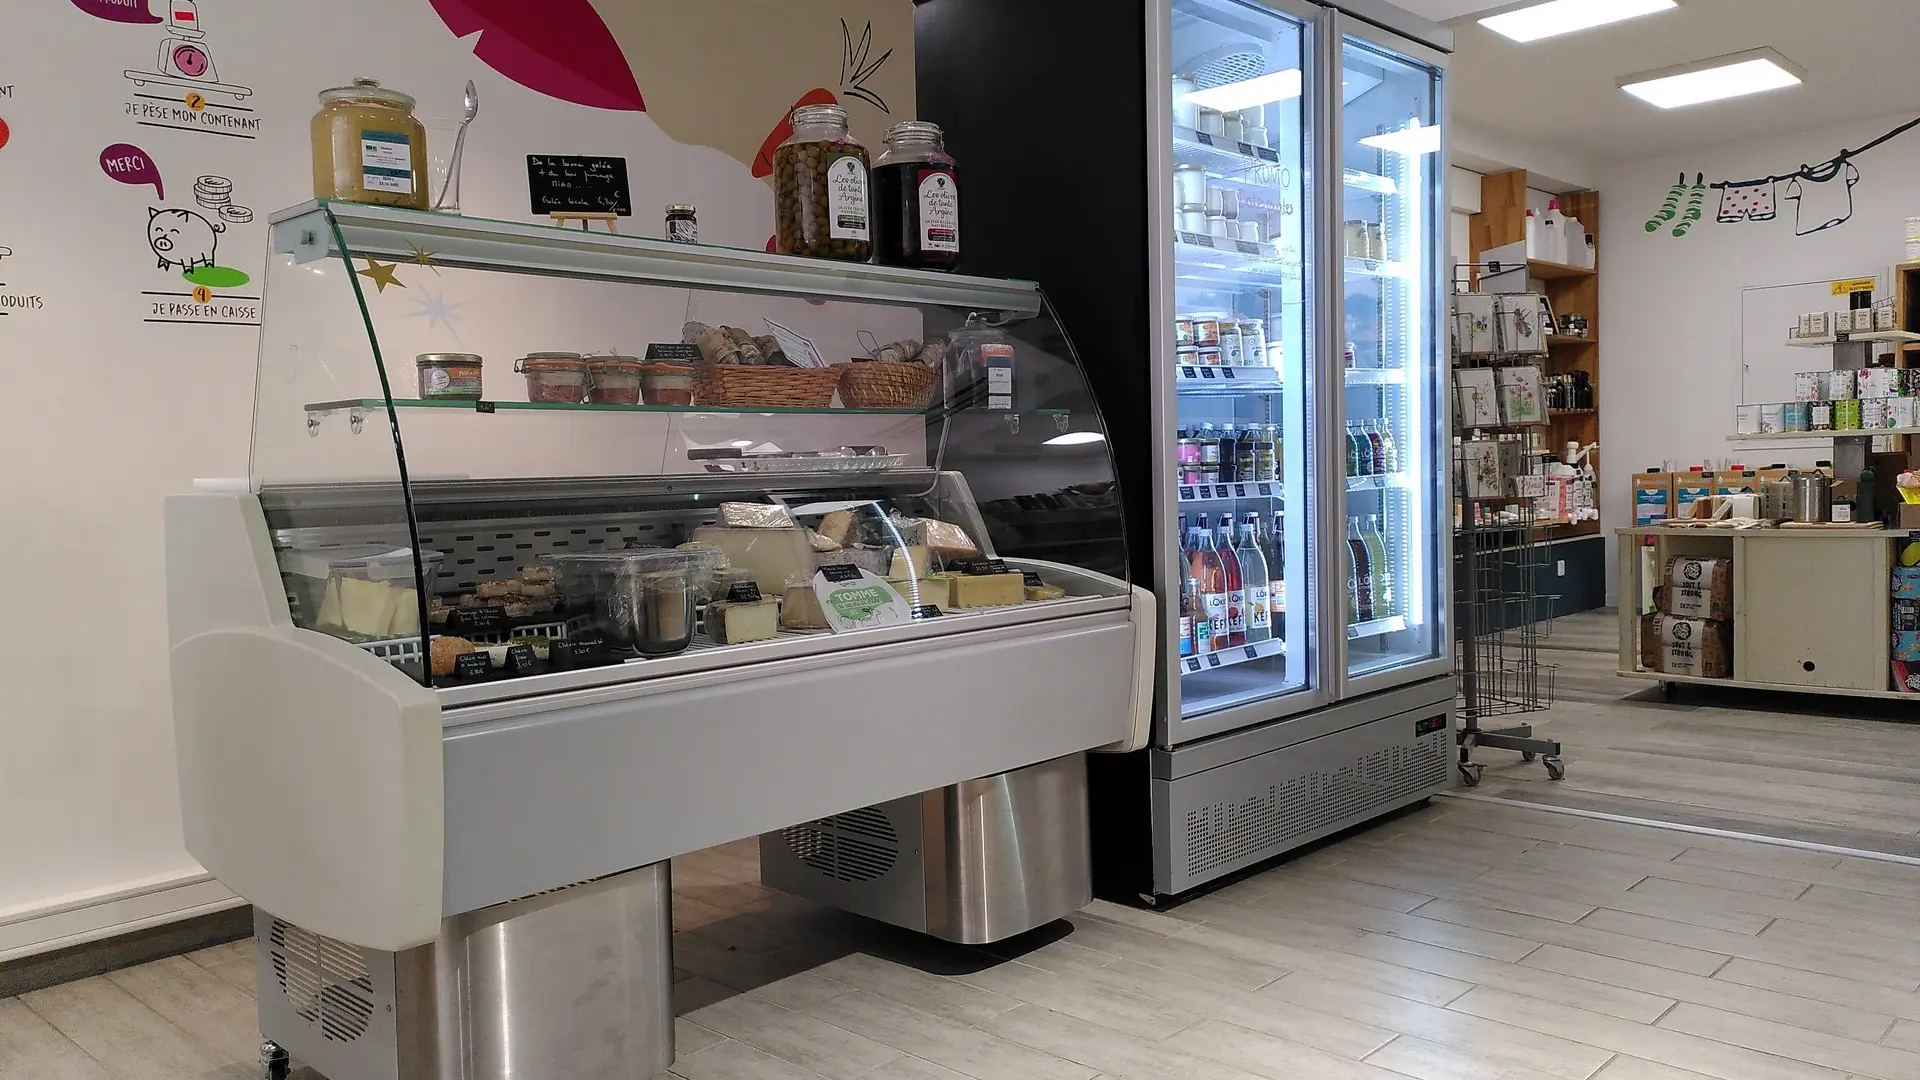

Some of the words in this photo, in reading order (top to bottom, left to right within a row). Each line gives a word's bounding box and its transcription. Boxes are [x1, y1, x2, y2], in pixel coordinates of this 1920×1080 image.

[191, 95, 201, 108] 2
[125, 103, 139, 116] JE
[143, 102, 169, 119] PÈSE
[173, 109, 197, 122] MON
[200, 111, 262, 131] CONTENANT
[106, 155, 146, 172] MERCI
[832, 174, 849, 183] Les
[838, 184, 847, 192] de
[923, 190, 939, 198] Les
[198, 289, 206, 302] 4
[152, 303, 165, 316] JE
[170, 303, 201, 317] PASSE
[204, 304, 218, 317] EN
[221, 306, 256, 319] CAISSE
[834, 588, 879, 602] TOMME
